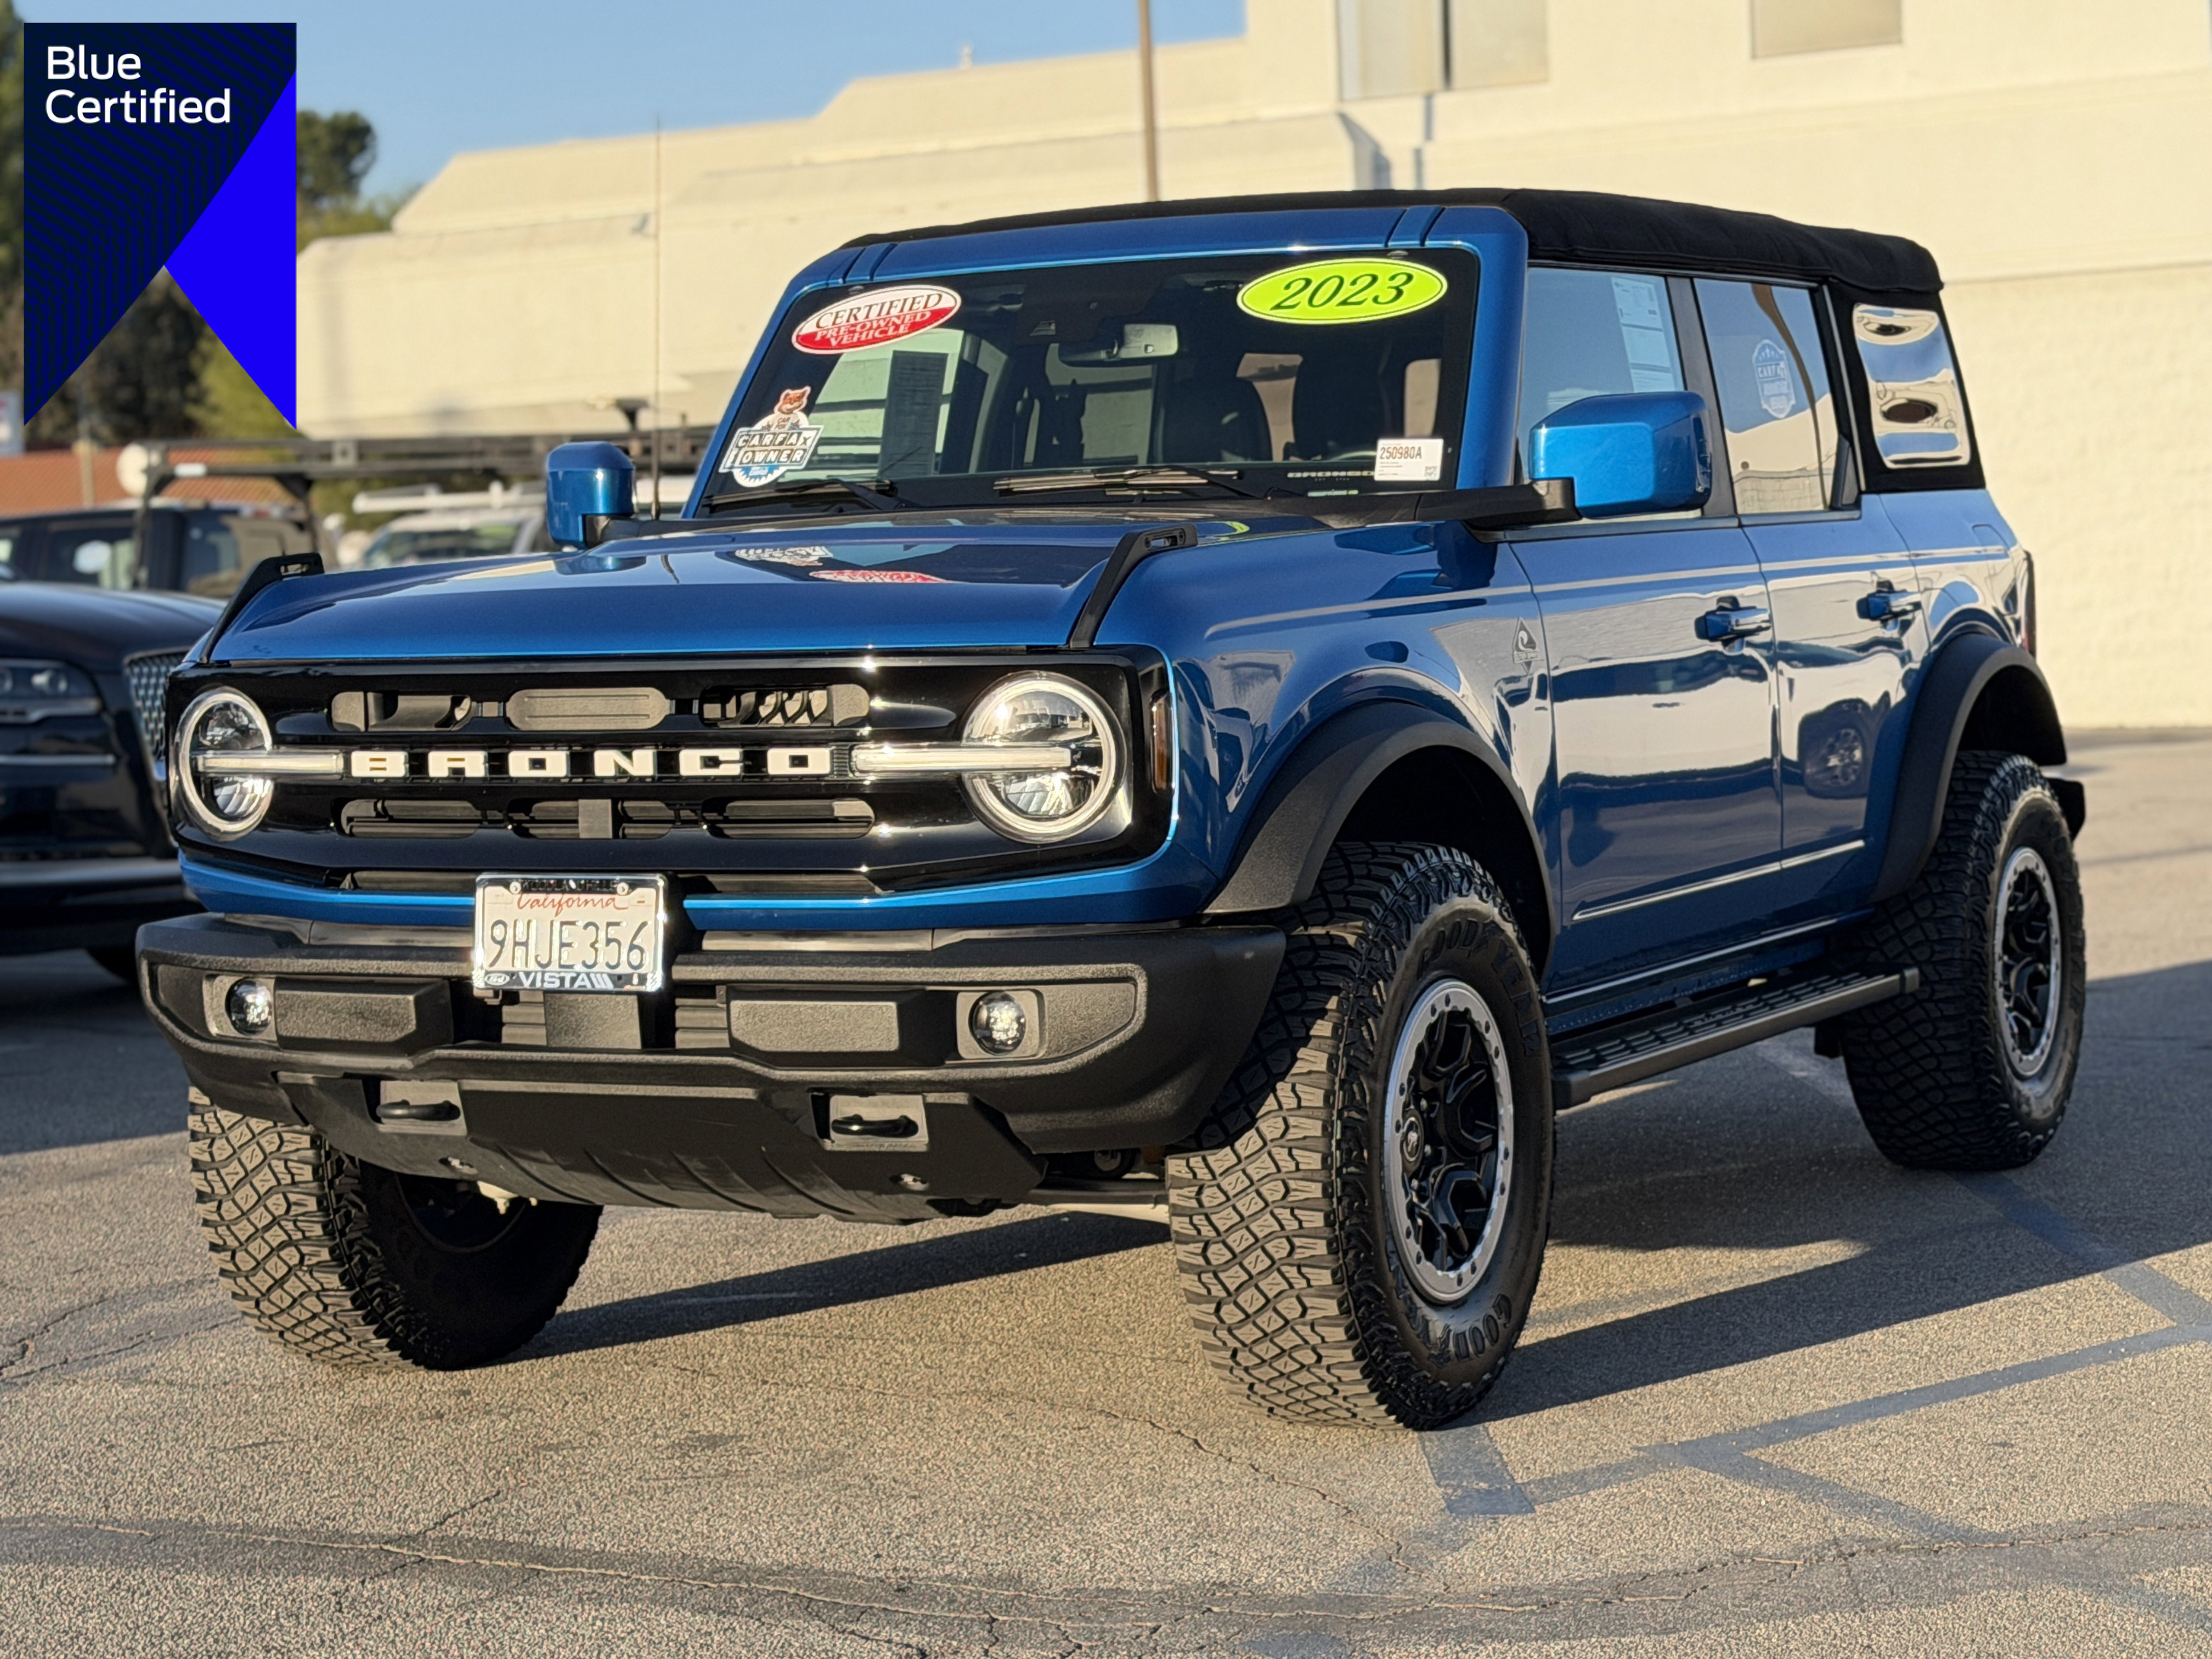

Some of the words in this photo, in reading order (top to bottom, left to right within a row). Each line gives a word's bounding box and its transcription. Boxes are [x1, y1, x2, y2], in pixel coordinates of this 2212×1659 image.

[1269, 271, 1414, 312] 2023
[815, 292, 943, 329] CERTIFIED
[814, 311, 932, 341] PRE-OWNED
[829, 324, 911, 347] VEHICLE
[737, 432, 812, 448] CARFAX
[741, 449, 810, 465] OWNER
[1379, 446, 1422, 460] 250980A
[350, 746, 832, 778] BRONCO
[517, 894, 629, 918] California
[488, 919, 652, 970] 9HJE356
[518, 971, 597, 989] VISTA
